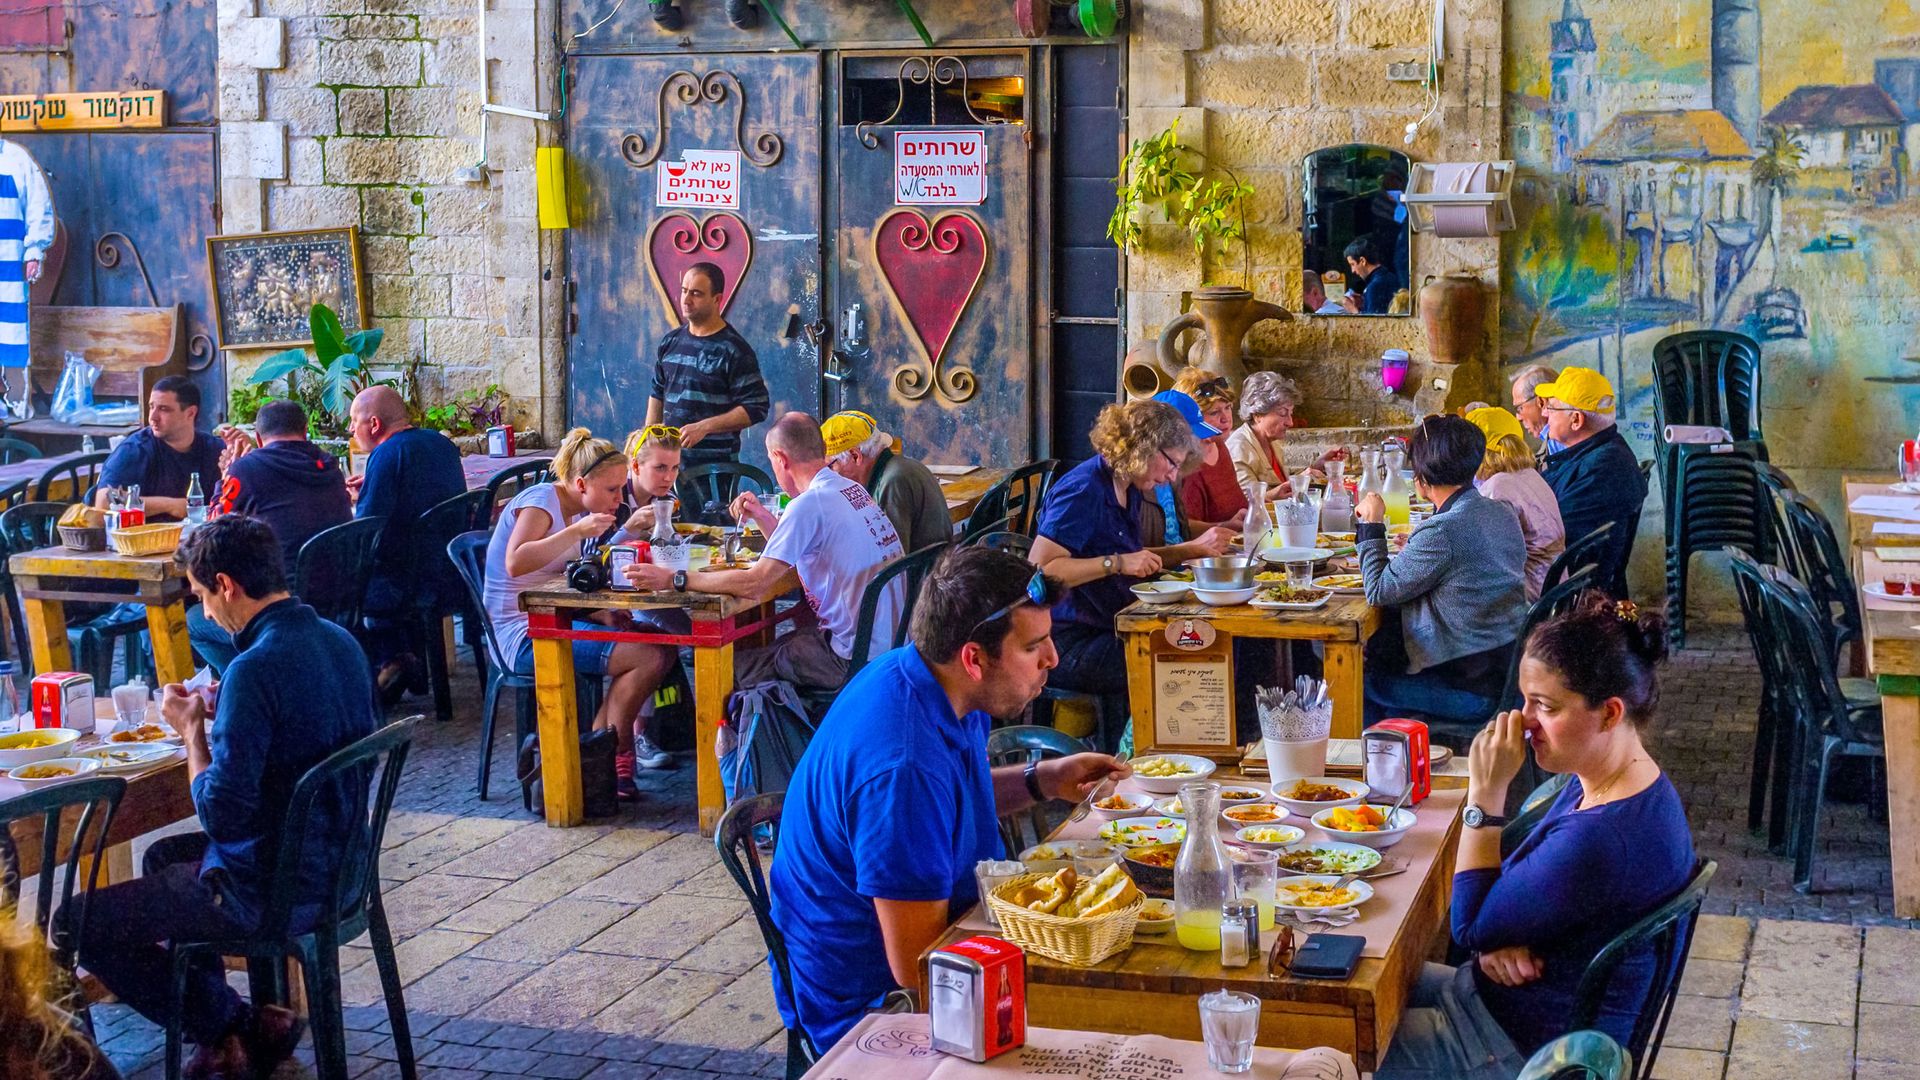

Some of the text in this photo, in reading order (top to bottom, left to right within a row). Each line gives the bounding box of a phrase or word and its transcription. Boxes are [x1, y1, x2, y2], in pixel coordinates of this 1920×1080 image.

[5, 96, 155, 125] דוקטור שקשו
[903, 141, 976, 156] שרותים
[691, 160, 731, 174] כאן לא
[901, 161, 980, 177] לאורחי המסעדה
[669, 177, 731, 190] שרותים
[924, 182, 957, 197] בלבד
[666, 191, 733, 204] ציבוריים
